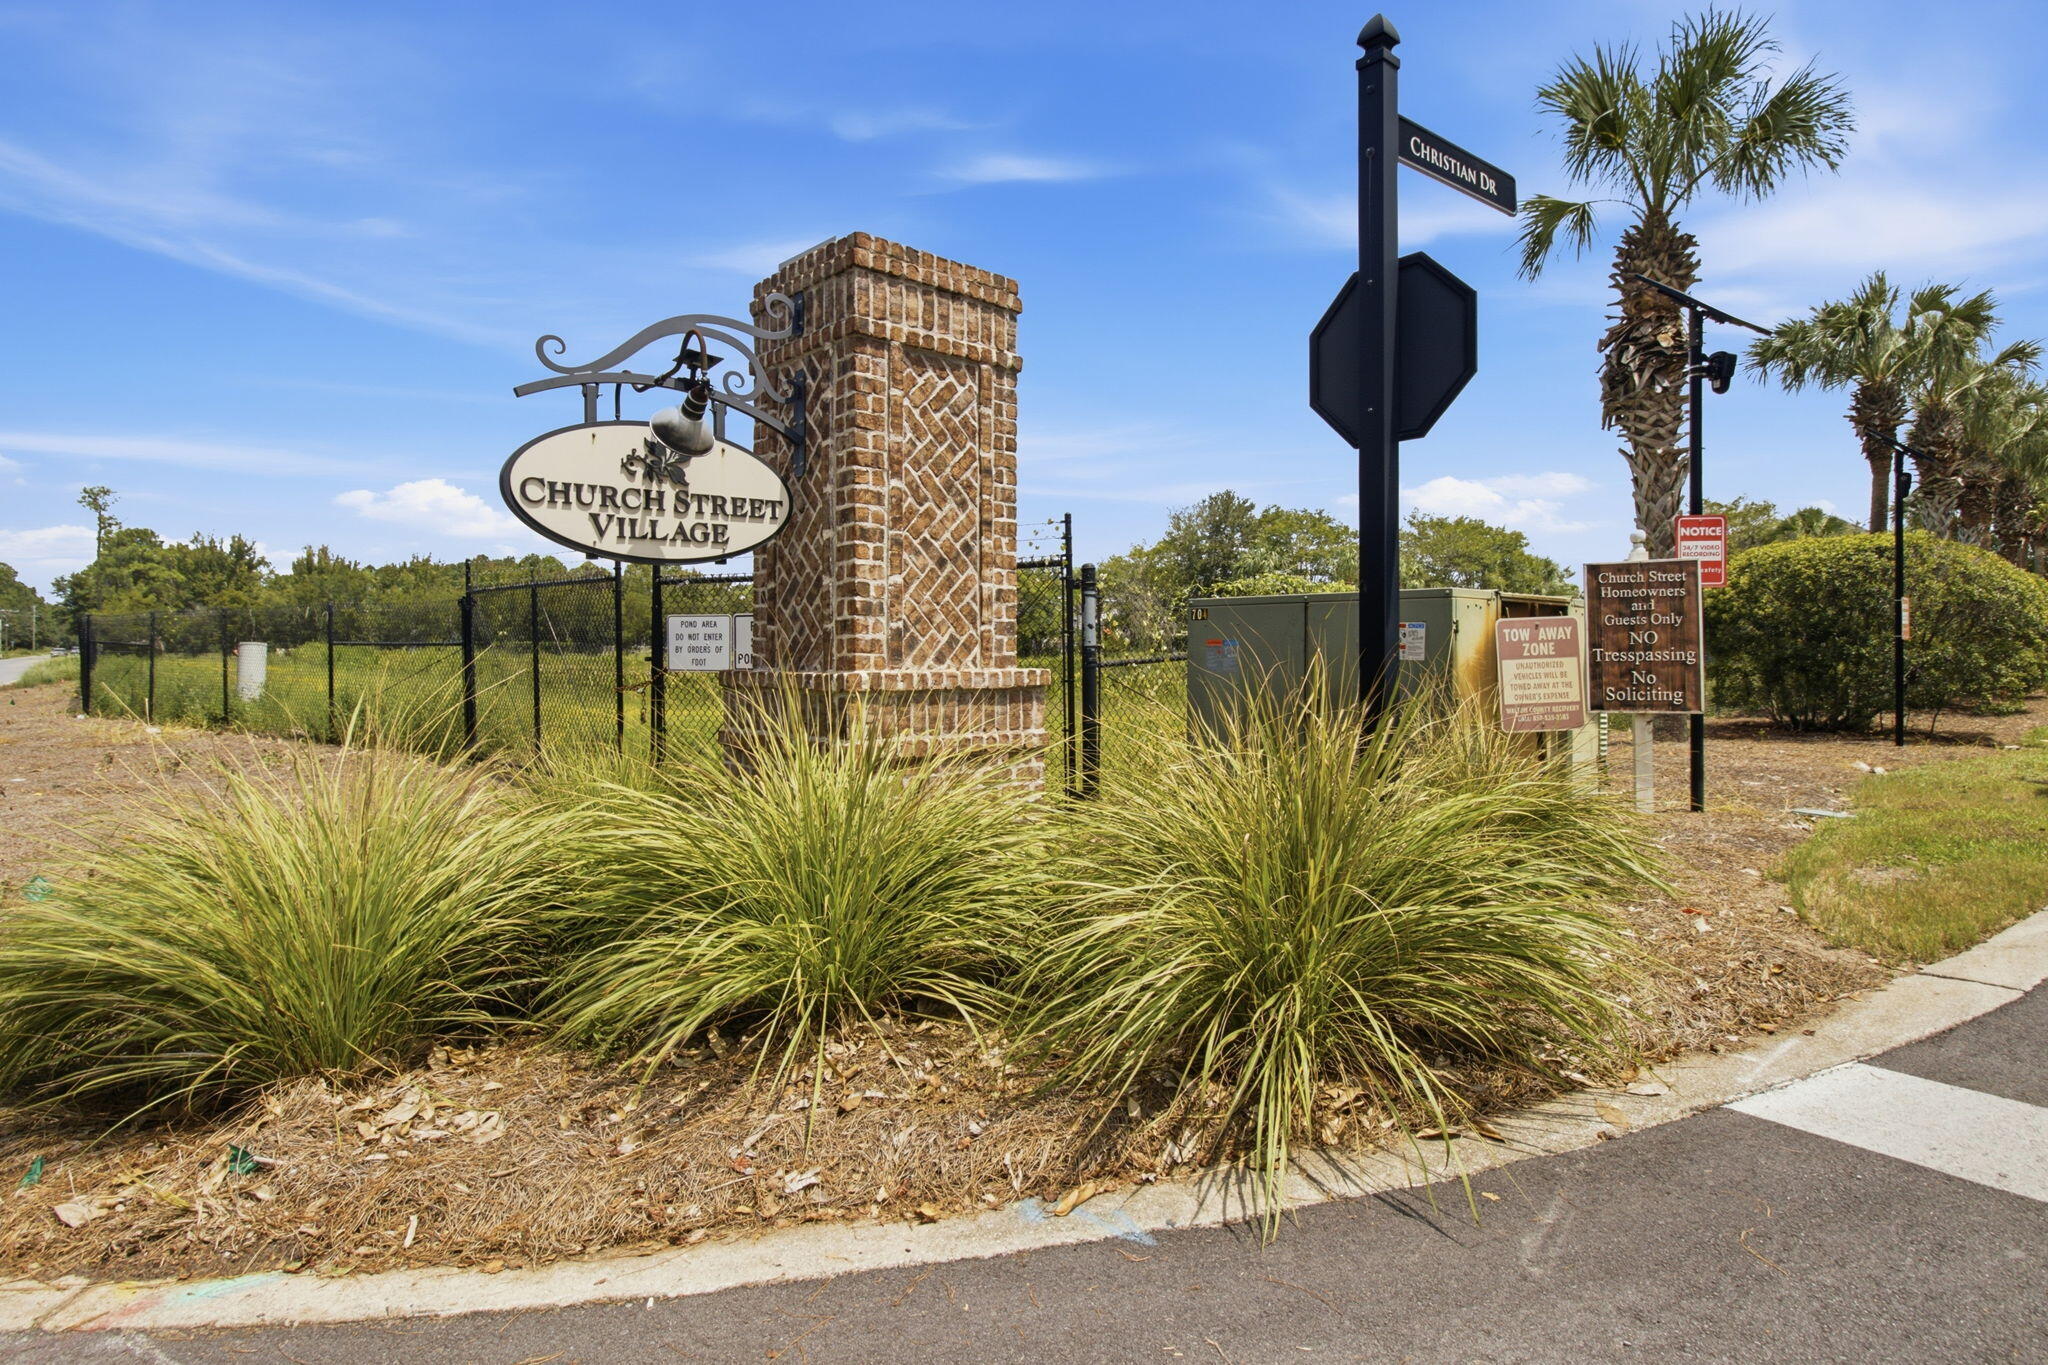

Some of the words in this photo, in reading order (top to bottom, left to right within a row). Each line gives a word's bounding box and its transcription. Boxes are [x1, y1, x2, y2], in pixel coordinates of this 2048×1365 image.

[1411, 136, 1476, 185] CHRISTIAN
[1480, 172, 1497, 195] DR
[519, 477, 665, 512] CHURCH
[673, 489, 783, 520] STREET
[588, 512, 730, 545] VILLAGE
[1681, 527, 1722, 536] NOTICE
[1598, 572, 1644, 584] Church
[1649, 570, 1687, 582] Street
[1600, 586, 1686, 598] Homeowners
[1631, 600, 1655, 611] and
[680, 620, 697, 628] POND
[702, 620, 717, 628] AREA
[1604, 614, 1647, 626] Guests
[1651, 613, 1683, 627] Only
[1503, 628, 1530, 642] TOW
[1538, 626, 1572, 641] AWAY
[1629, 631, 1658, 645] NO
[1522, 642, 1556, 656] ZONE
[1593, 647, 1696, 665] Tresspassing
[1516, 661, 1564, 670] UNAUTHORIZED
[1514, 672, 1542, 680] VEHICLES
[1632, 670, 1656, 685] No
[1510, 683, 1531, 691] TOWED
[1543, 692, 1569, 700] EXPENSE
[1606, 687, 1683, 704] Soliciting
